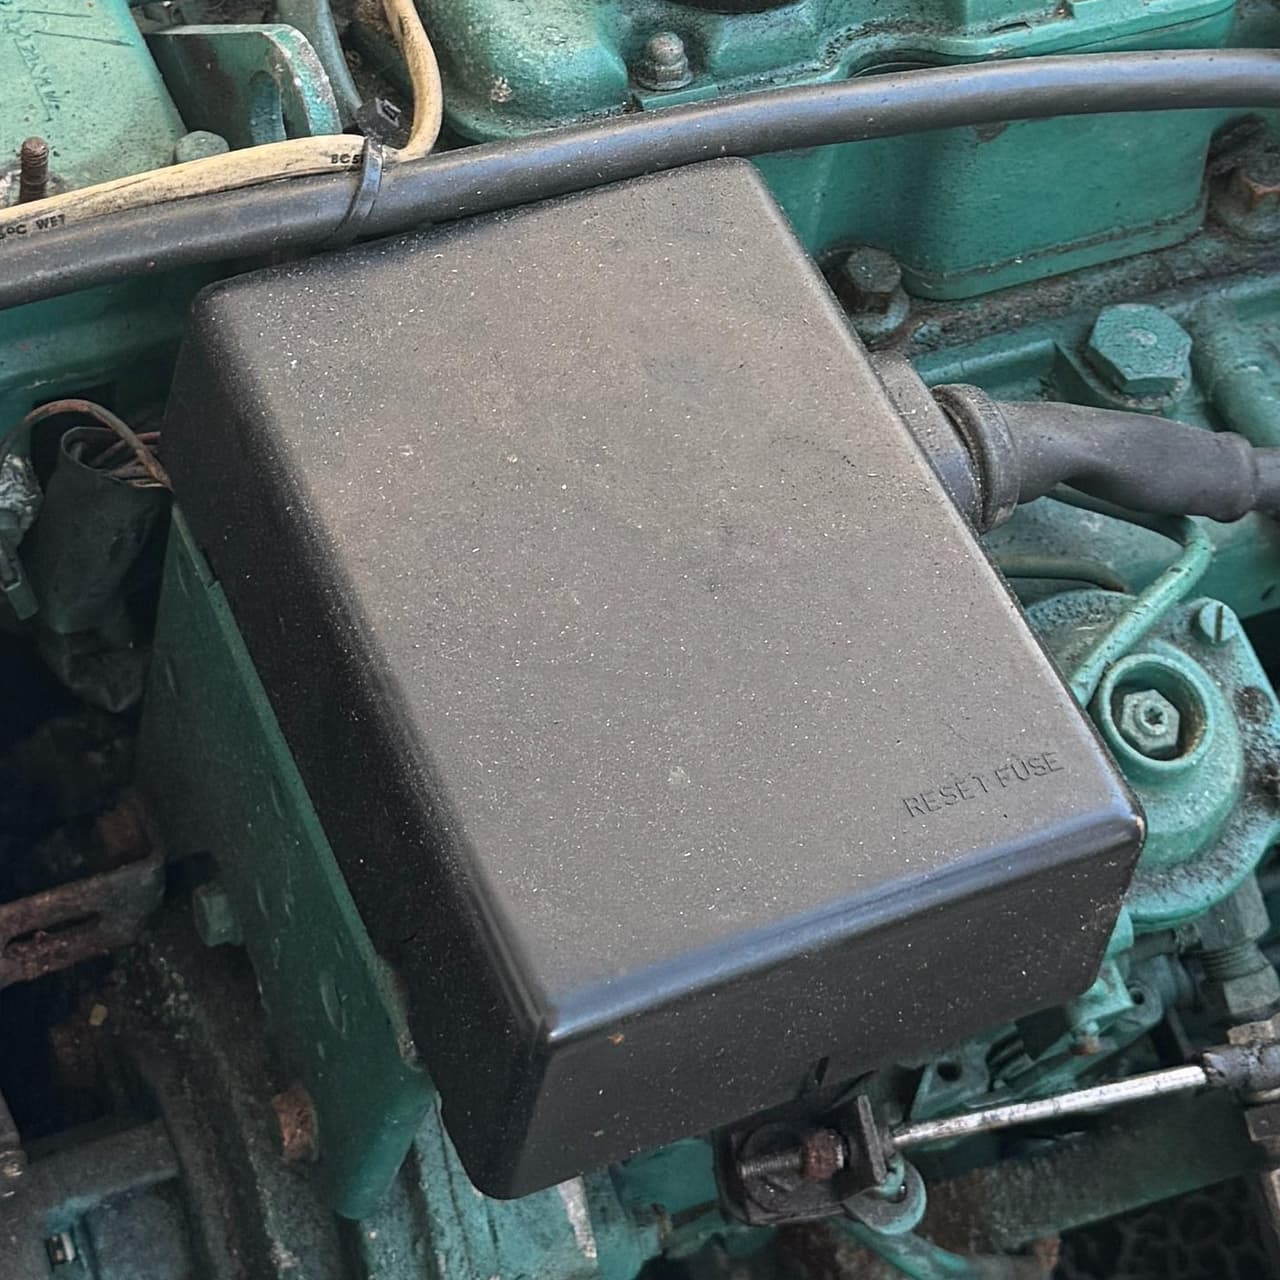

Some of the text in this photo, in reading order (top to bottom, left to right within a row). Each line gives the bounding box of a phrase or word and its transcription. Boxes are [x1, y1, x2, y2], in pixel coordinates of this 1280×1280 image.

[36, 213, 66, 230] WET
[903, 751, 1065, 818] RESET FUSE
